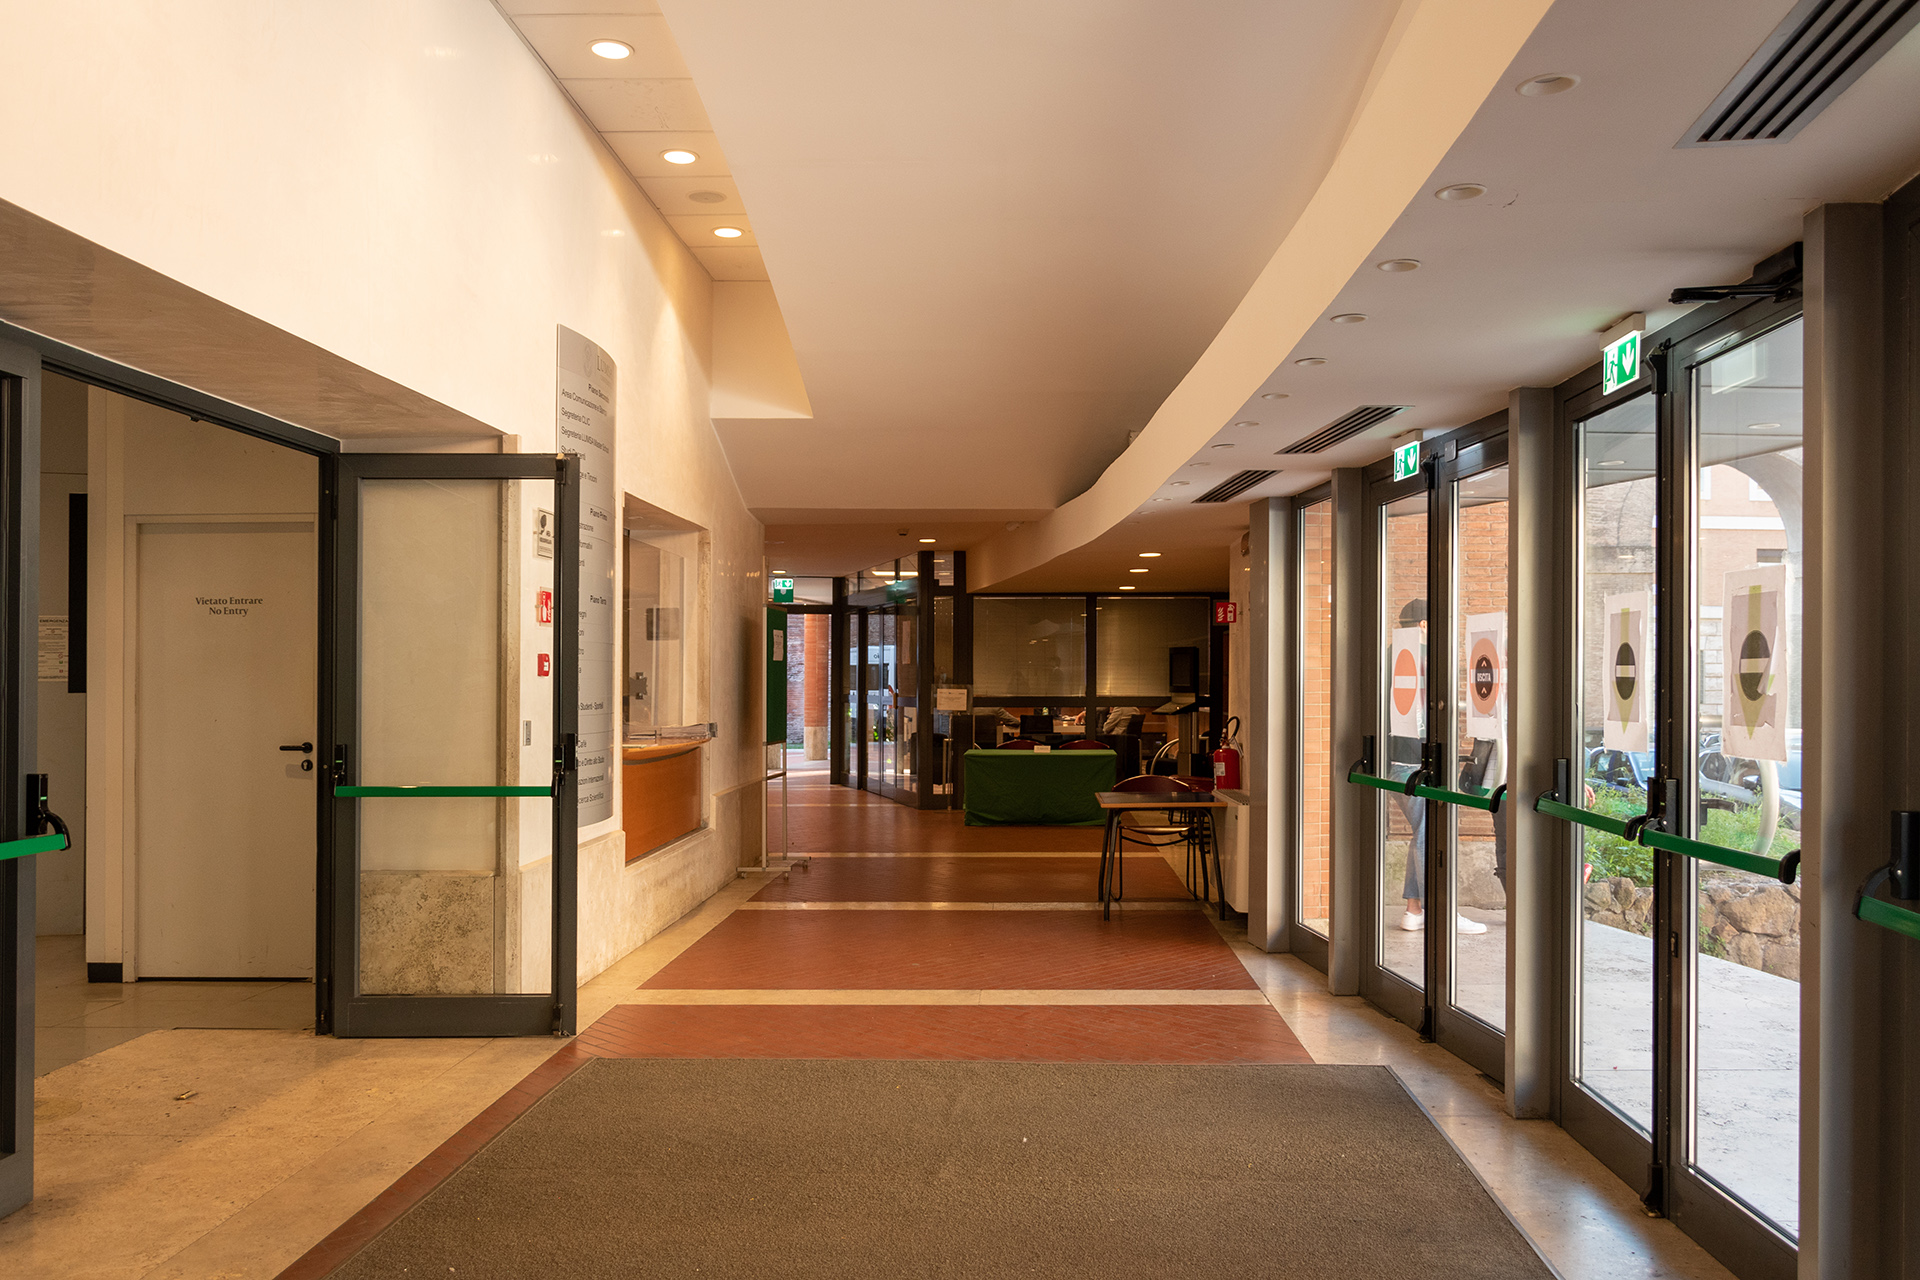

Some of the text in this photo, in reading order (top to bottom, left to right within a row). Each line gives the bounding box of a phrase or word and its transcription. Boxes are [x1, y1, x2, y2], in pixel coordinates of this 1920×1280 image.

[561, 388, 572, 400] Area
[588, 383, 599, 396] Piano
[561, 407, 581, 423] Segreteria
[561, 425, 581, 441] Segreteria
[590, 507, 600, 518] Piano
[195, 597, 264, 605] Vietato Entrare
[590, 594, 600, 604] Piano
[209, 607, 249, 617] No Entry
[1476, 672, 1492, 682] USCITA
